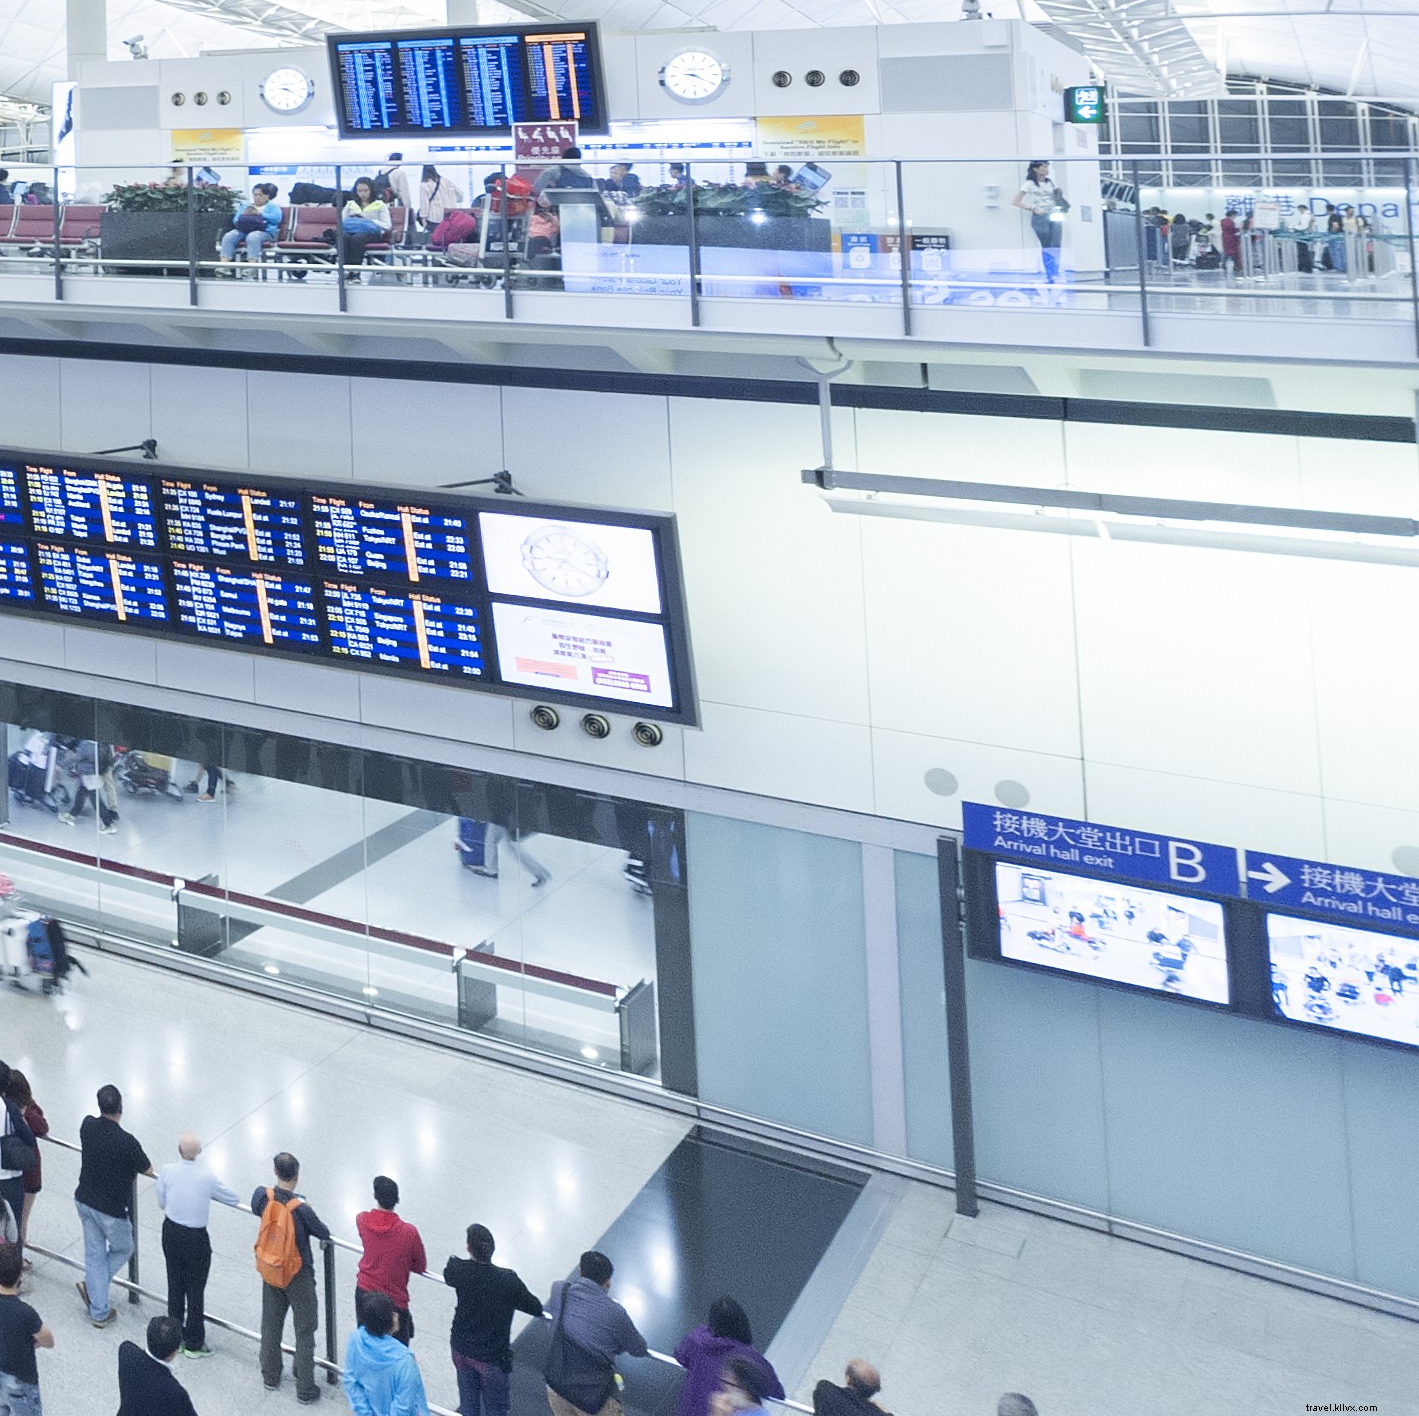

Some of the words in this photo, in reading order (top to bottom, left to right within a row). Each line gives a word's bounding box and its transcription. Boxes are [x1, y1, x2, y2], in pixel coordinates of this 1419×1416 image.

[993, 811, 1160, 858] 接機大堂出口
[1168, 841, 1206, 882] B
[994, 836, 1046, 856] Arrival
[1050, 846, 1080, 862] hall
[1083, 853, 1114, 868] exit
[1300, 864, 1419, 906] 接機大堂
[1302, 892, 1363, 914] Arrival
[1366, 902, 1402, 921] hall
